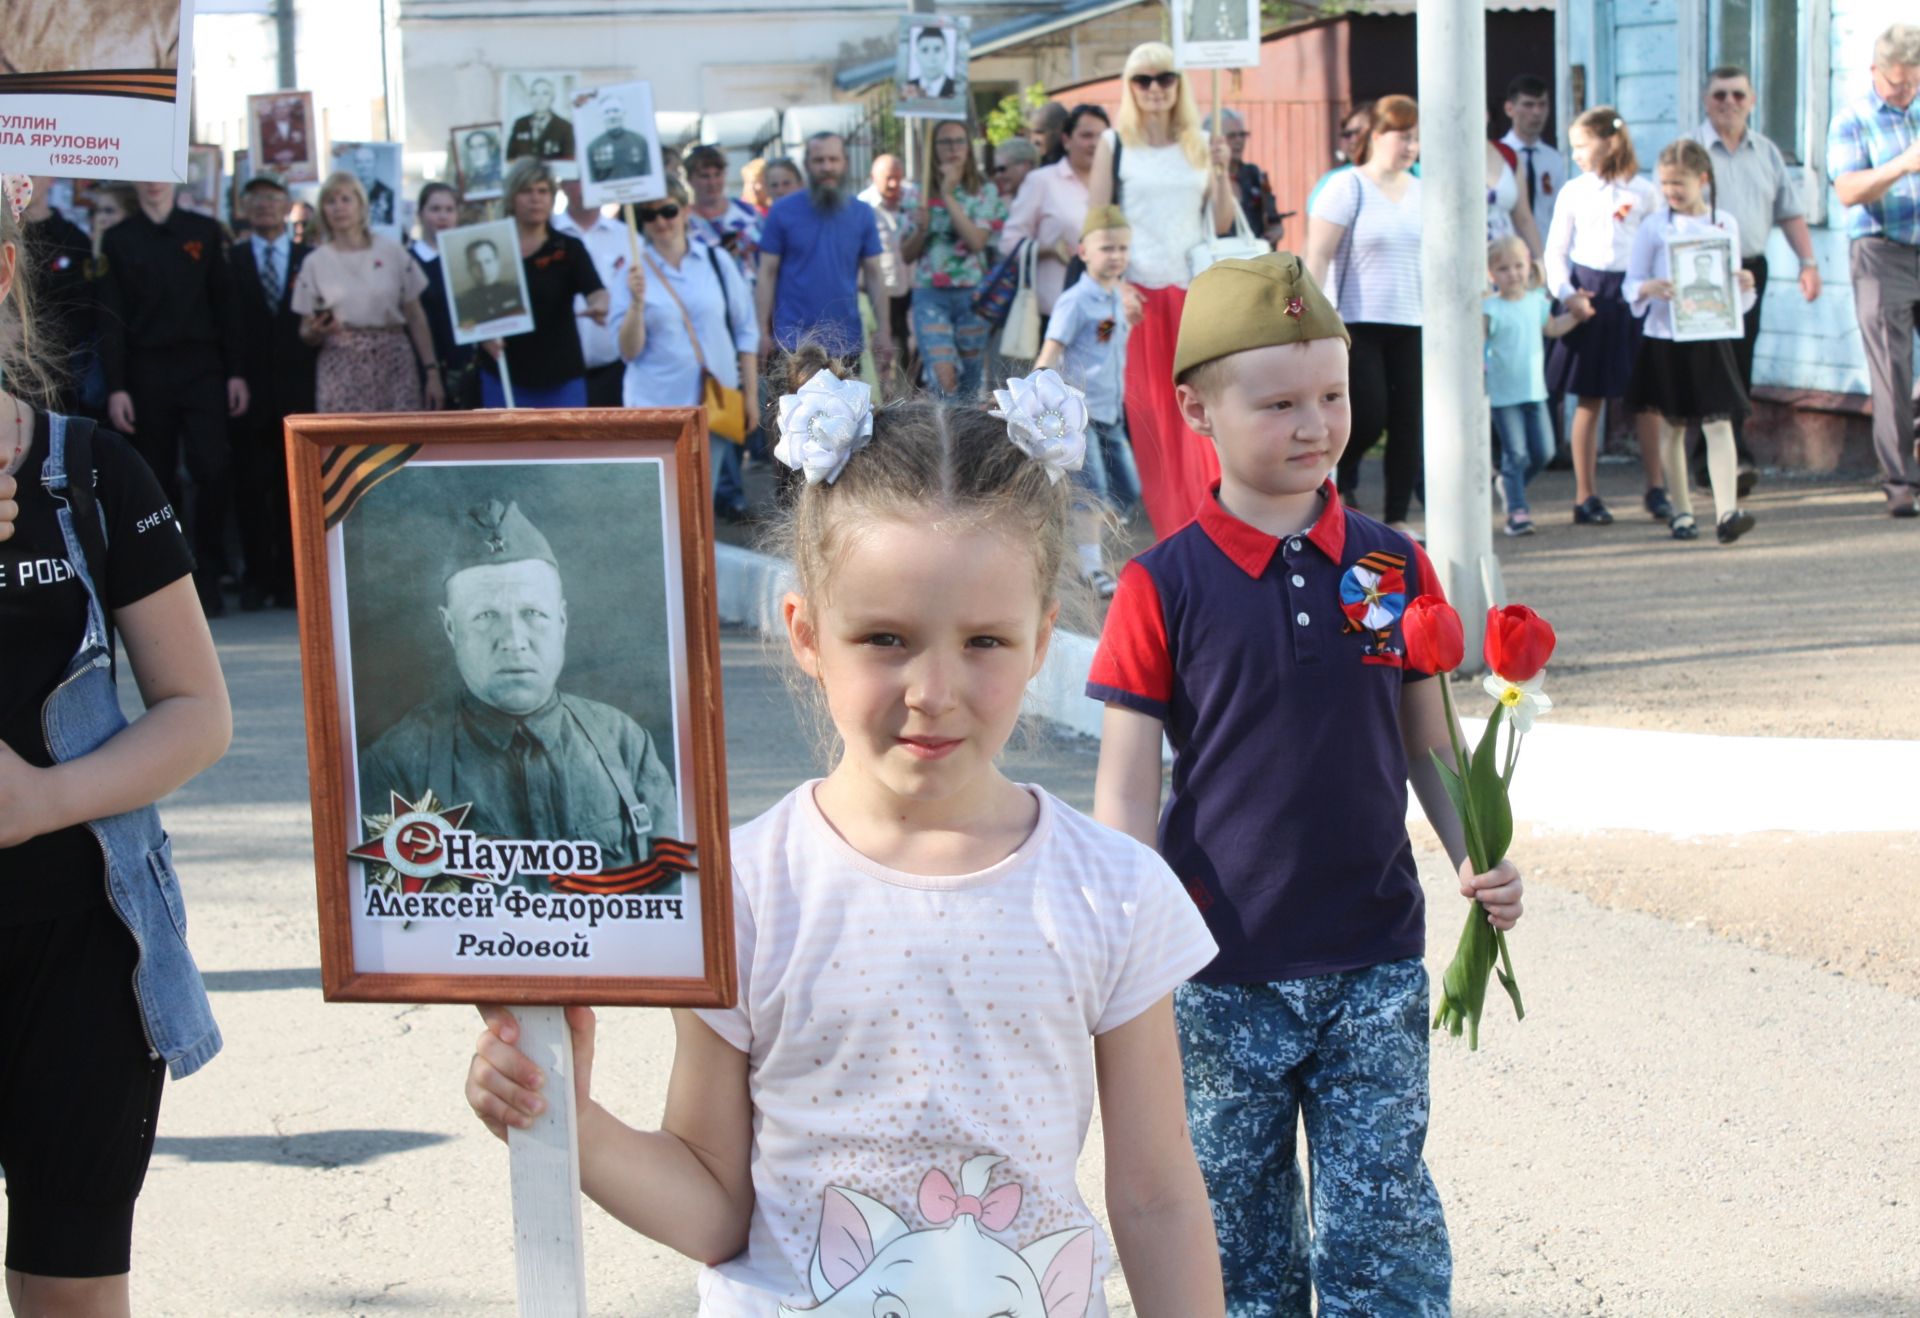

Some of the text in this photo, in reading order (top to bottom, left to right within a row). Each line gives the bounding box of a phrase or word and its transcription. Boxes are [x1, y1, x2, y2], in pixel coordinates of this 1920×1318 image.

[0, 132, 120, 151] ЛА ЯРУЛОВИЧ
[50, 153, 119, 168] (1925-2007)
[136, 512, 161, 533] SHE
[443, 834, 599, 880] Наумов
[366, 888, 684, 927] Алексей Федорович
[456, 932, 592, 958] Рядовой
